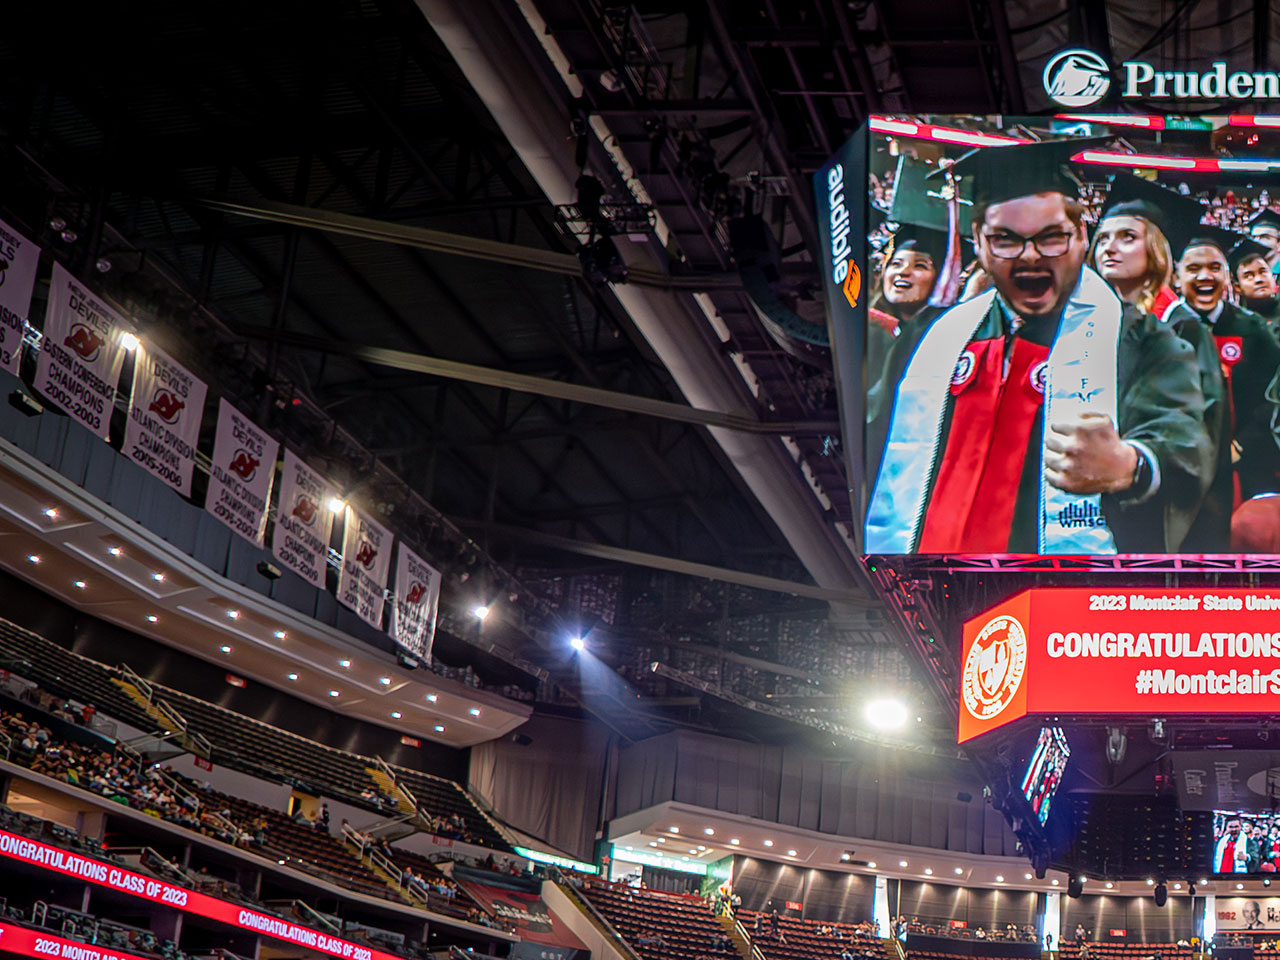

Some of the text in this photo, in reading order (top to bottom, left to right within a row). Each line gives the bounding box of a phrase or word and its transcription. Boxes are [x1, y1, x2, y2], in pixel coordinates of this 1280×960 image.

[828, 163, 852, 285] audible
[69, 294, 110, 336] DEVILS
[49, 362, 104, 415] CHAMPIONS
[154, 363, 188, 399] DEVILS
[44, 380, 101, 430] 2002-2003
[132, 406, 196, 461] ATLANTIC DIVISION
[140, 431, 181, 472] CHAMPIONS
[232, 425, 263, 458] DEVILS
[1089, 595, 1126, 612] 2023
[1130, 595, 1201, 613] Montclair
[1203, 595, 1242, 612] State
[0, 834, 187, 906] ONGRATULATIONS CLASS OF 2023
[35, 939, 60, 955] 2023
[239, 911, 316, 945] CONGRATULATIONS
[318, 936, 342, 953] CLASS
[343, 944, 353, 956] OF
